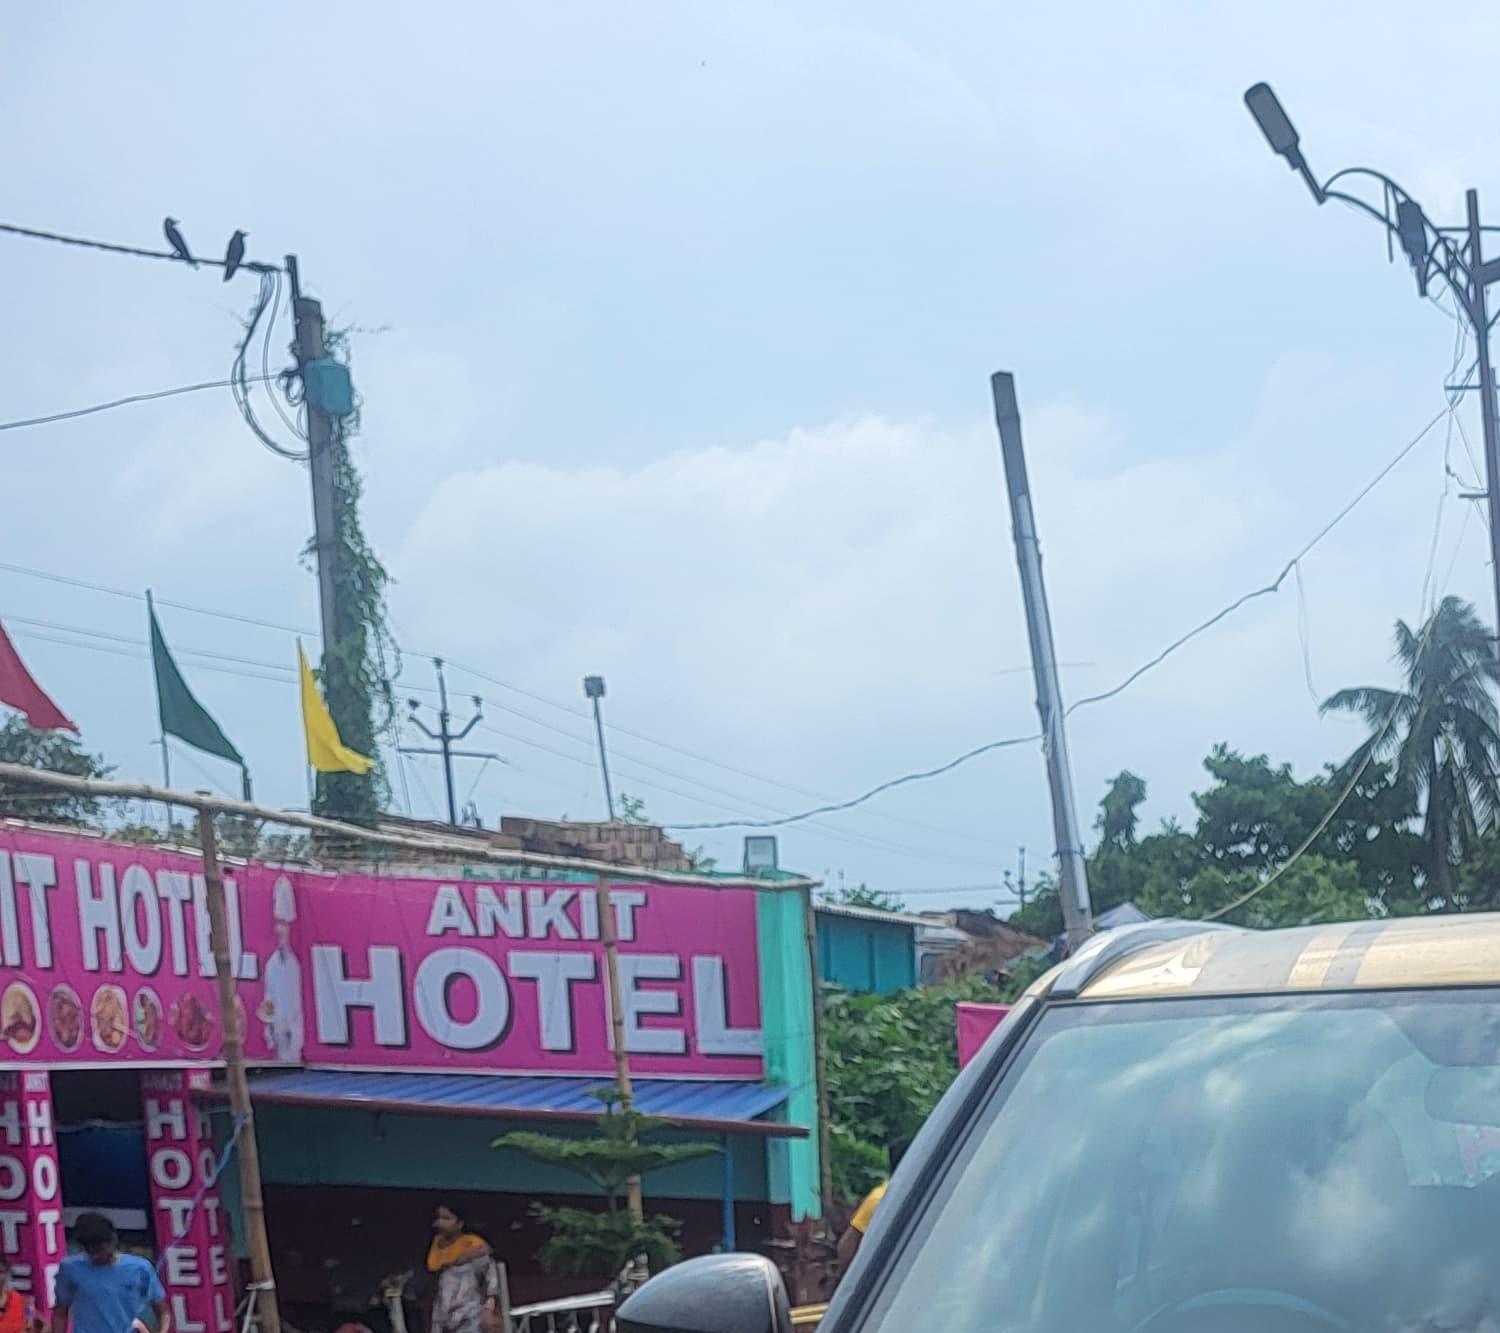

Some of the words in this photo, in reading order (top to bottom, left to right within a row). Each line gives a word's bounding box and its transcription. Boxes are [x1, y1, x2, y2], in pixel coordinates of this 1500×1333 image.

[0, 850, 55, 968] IT
[425, 885, 647, 942] ANKIT
[310, 944, 763, 1055] HOTEL
[145, 1099, 206, 1333] HOTEL
